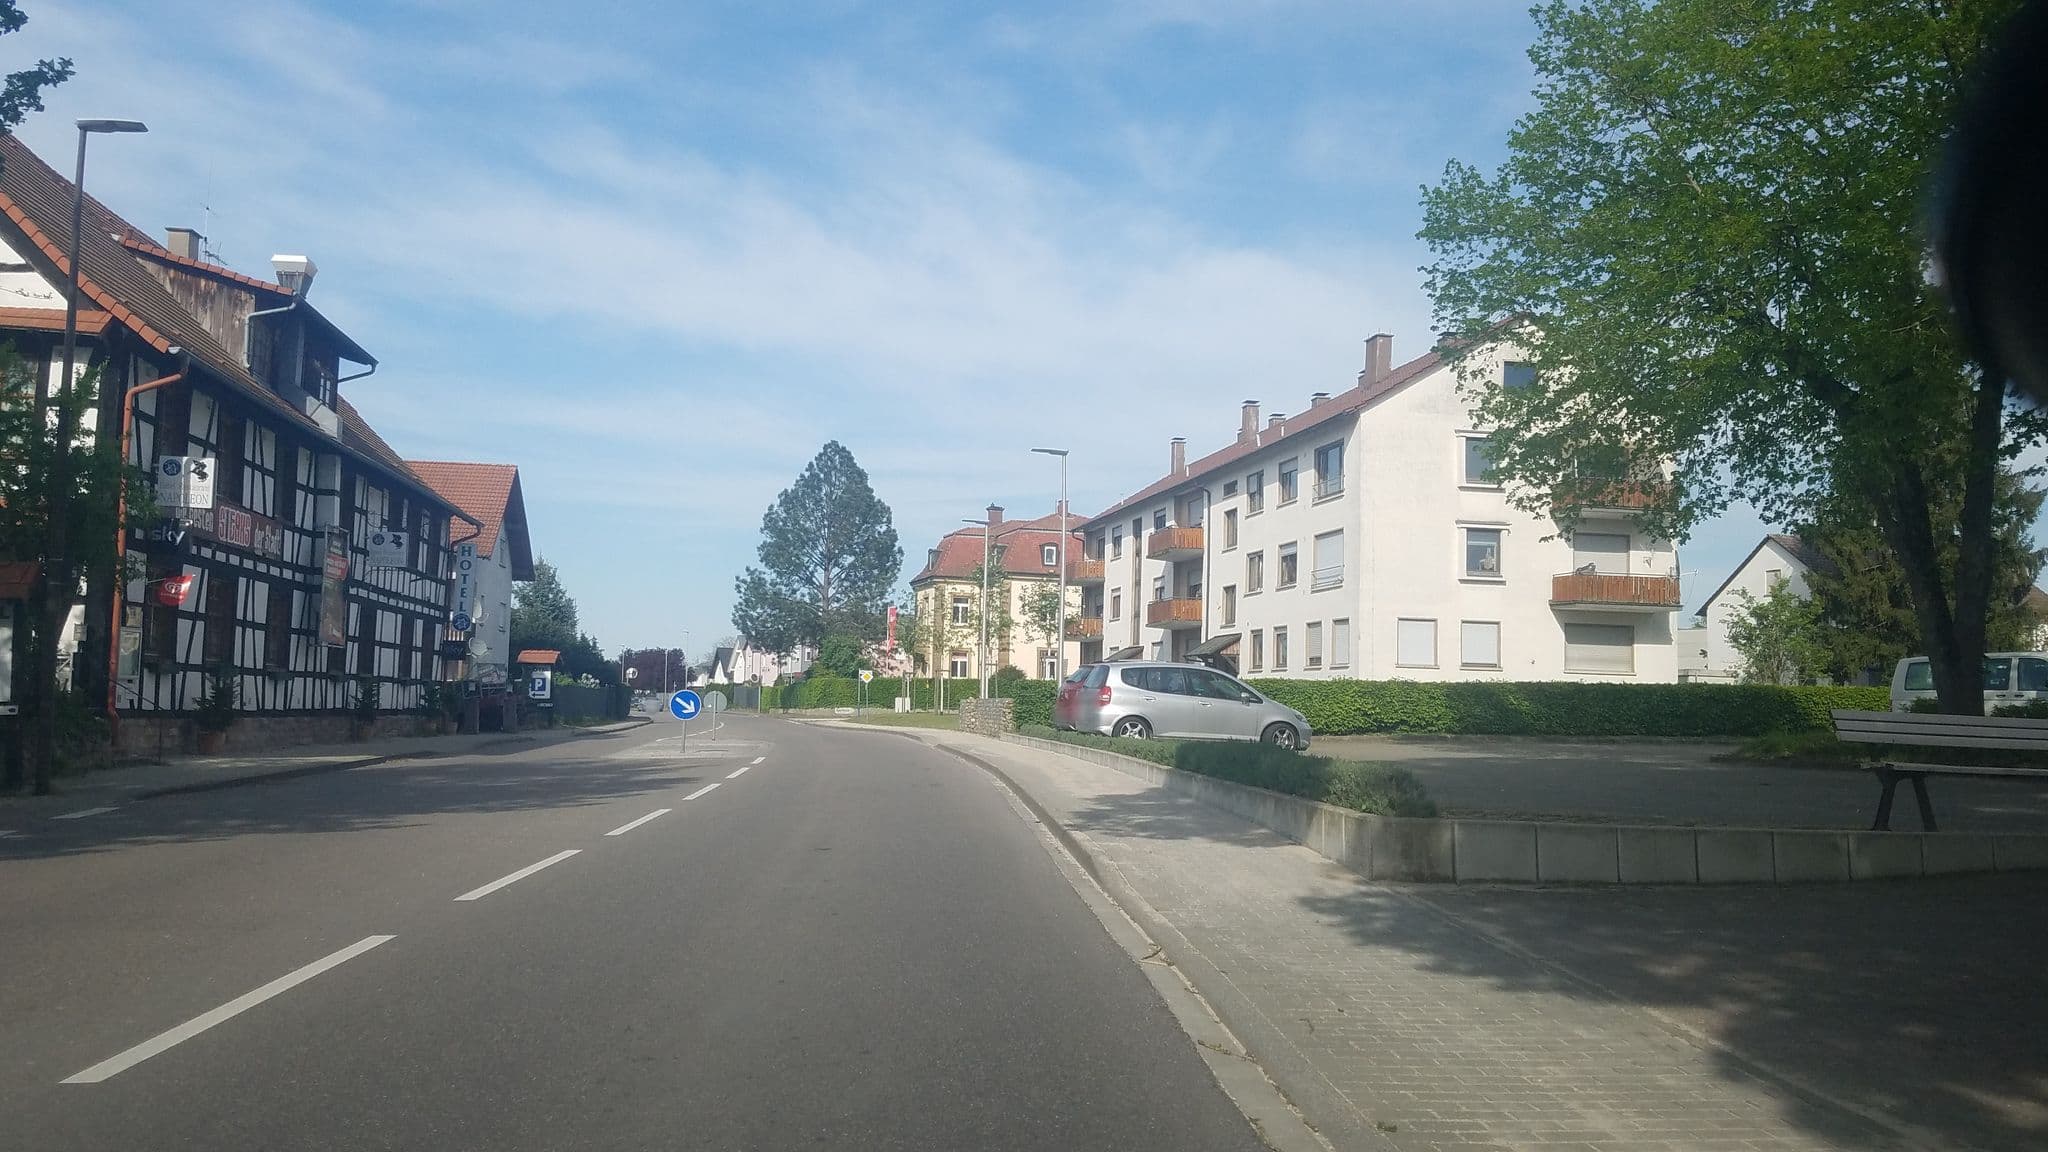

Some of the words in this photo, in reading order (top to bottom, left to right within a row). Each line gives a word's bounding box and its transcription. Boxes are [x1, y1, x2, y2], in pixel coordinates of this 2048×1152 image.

[159, 492, 209, 506] NAPOLEON
[152, 525, 186, 546] sky
[218, 505, 251, 547] STEAKS
[459, 545, 473, 612] HOTEL
[534, 678, 543, 691] P
